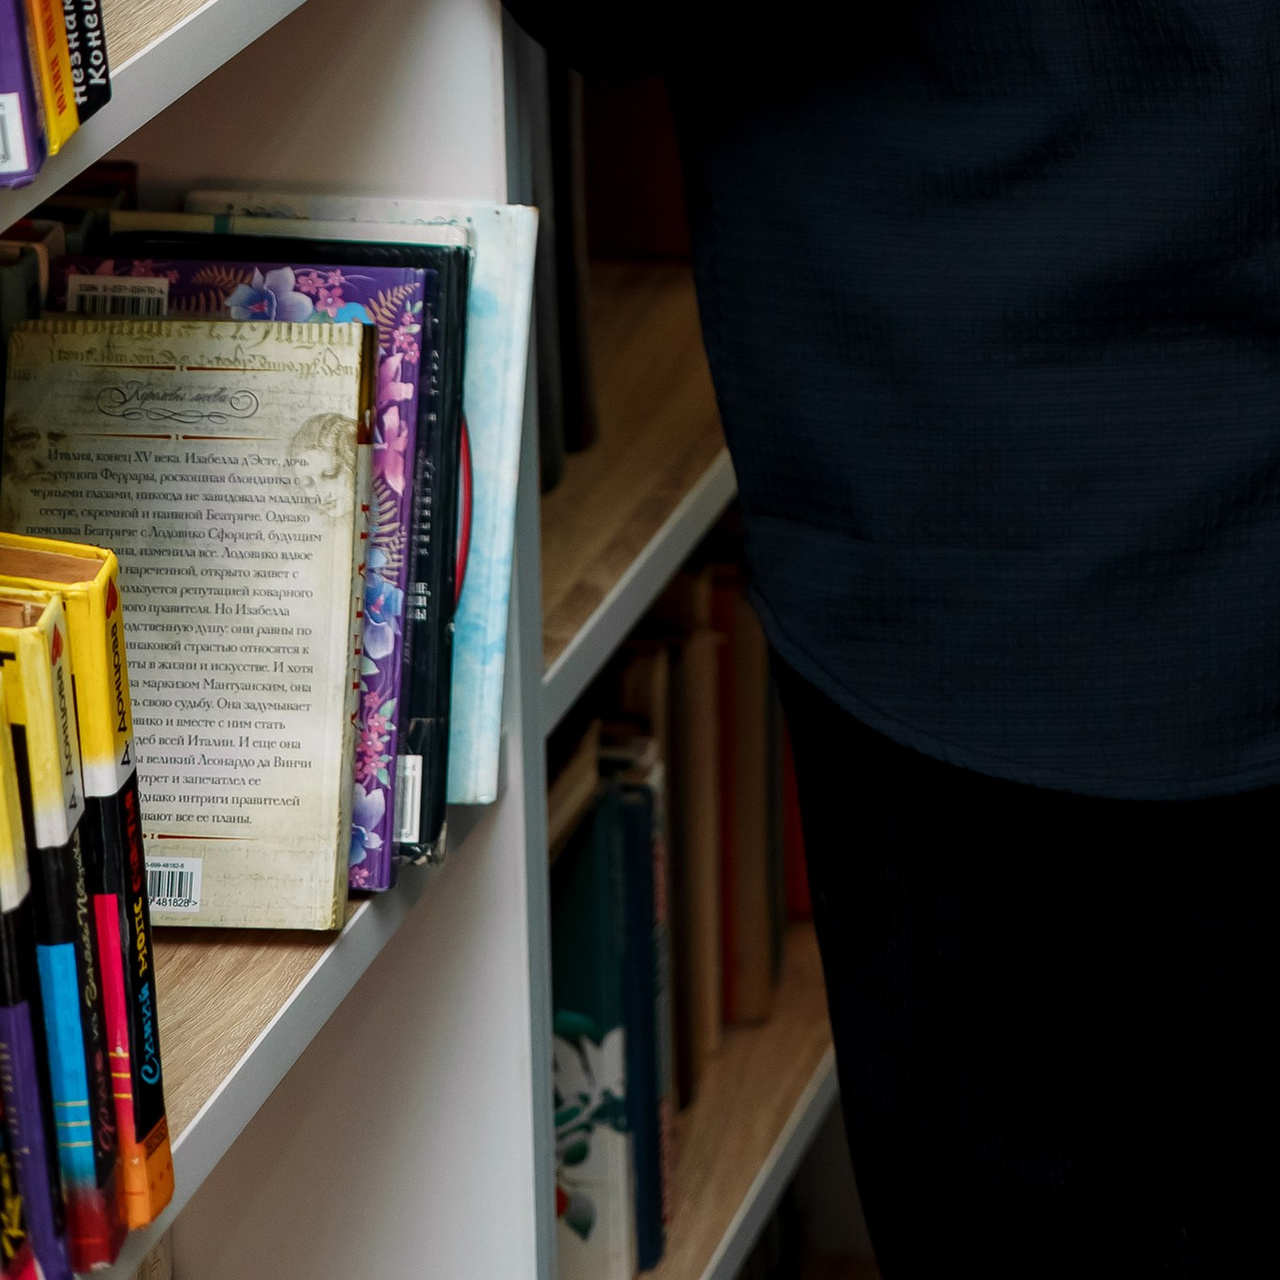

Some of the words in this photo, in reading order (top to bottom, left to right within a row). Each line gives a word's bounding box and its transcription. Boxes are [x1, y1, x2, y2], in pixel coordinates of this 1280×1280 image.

[47, 448, 93, 464] Италия,
[95, 453, 131, 465] конец
[134, 451, 153, 463] XV
[155, 455, 182, 464] века.
[185, 452, 239, 465] Изабелла
[148, 604, 211, 616] правителя.
[214, 603, 233, 615] Но
[235, 603, 290, 616] Изабелла
[142, 680, 200, 692] маркизом
[202, 678, 288, 694] Мантуанским,
[290, 684, 312, 693] она
[146, 754, 196, 765] великий
[197, 754, 256, 770] Леонардо
[256, 759, 271, 769] да
[273, 756, 312, 768] Винчи
[178, 794, 229, 808] интриги
[231, 794, 300, 808] правителей
[155, 897, 190, 908] 481828
[141, 981, 161, 1086] Синий
